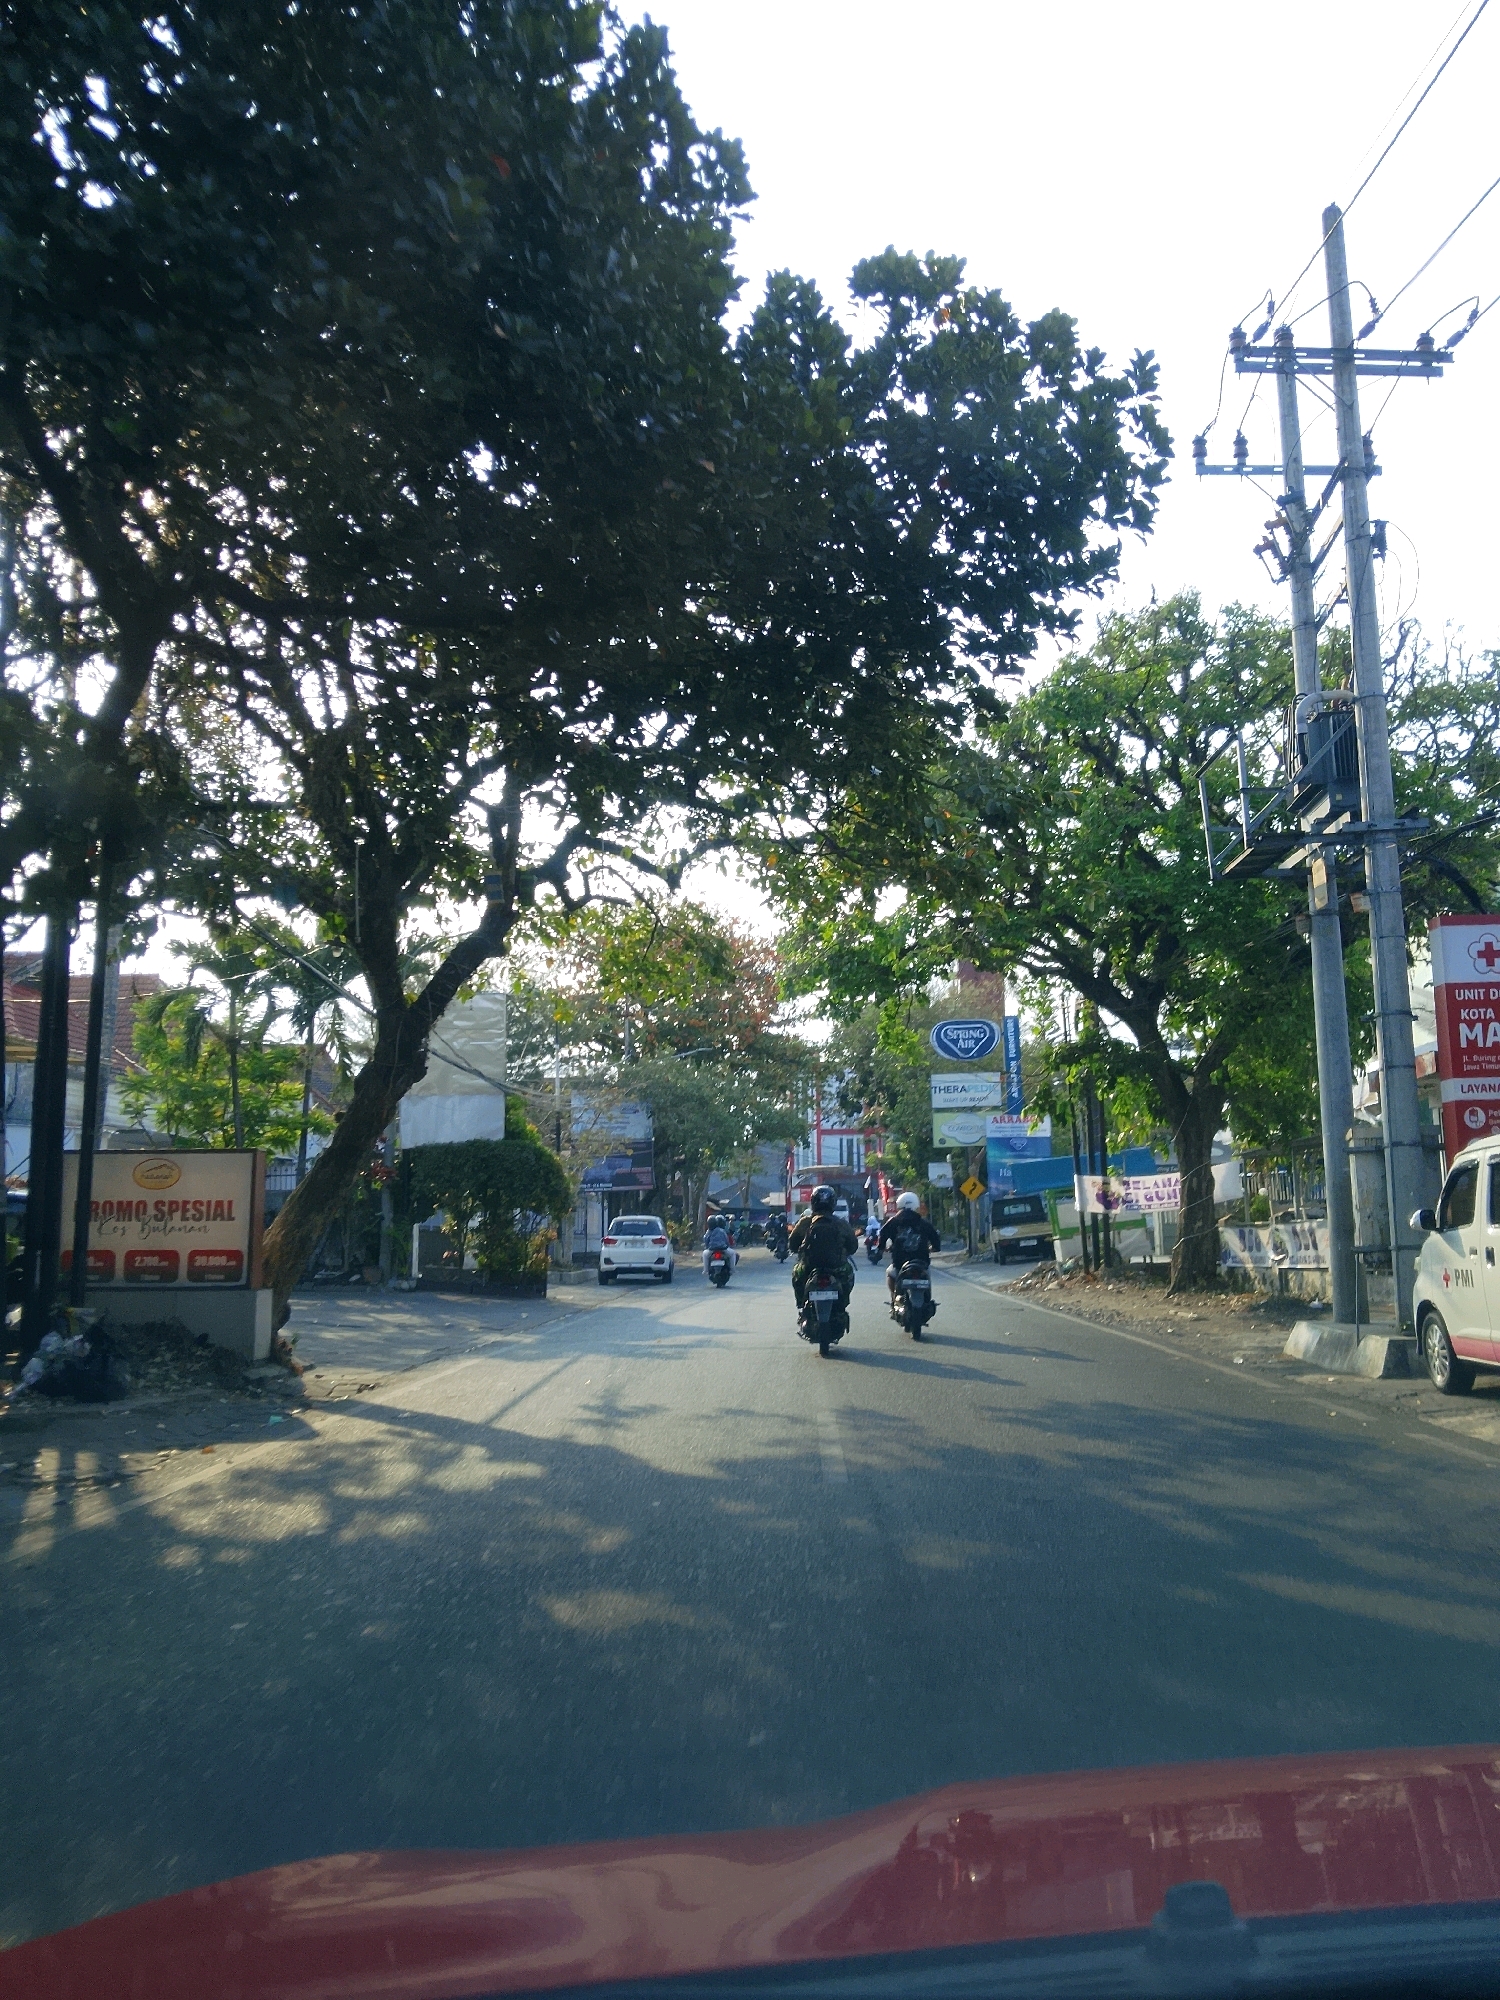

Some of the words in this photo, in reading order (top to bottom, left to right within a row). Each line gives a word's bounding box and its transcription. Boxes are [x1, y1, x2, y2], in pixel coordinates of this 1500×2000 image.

[1455, 989, 1485, 1000] UNIT
[1489, 988, 1500, 1000] D
[1460, 1008, 1495, 1020] KOTA
[946, 1028, 985, 1040] SPRING
[957, 1039, 976, 1049] AIR
[1460, 1083, 1500, 1094] LAYAN
[75, 1199, 148, 1222] ROMO
[152, 1199, 235, 1222] SPESIAL
[97, 1215, 128, 1237] Kos
[137, 1213, 211, 1241] Bulanan
[1454, 1268, 1474, 1288] PMI
